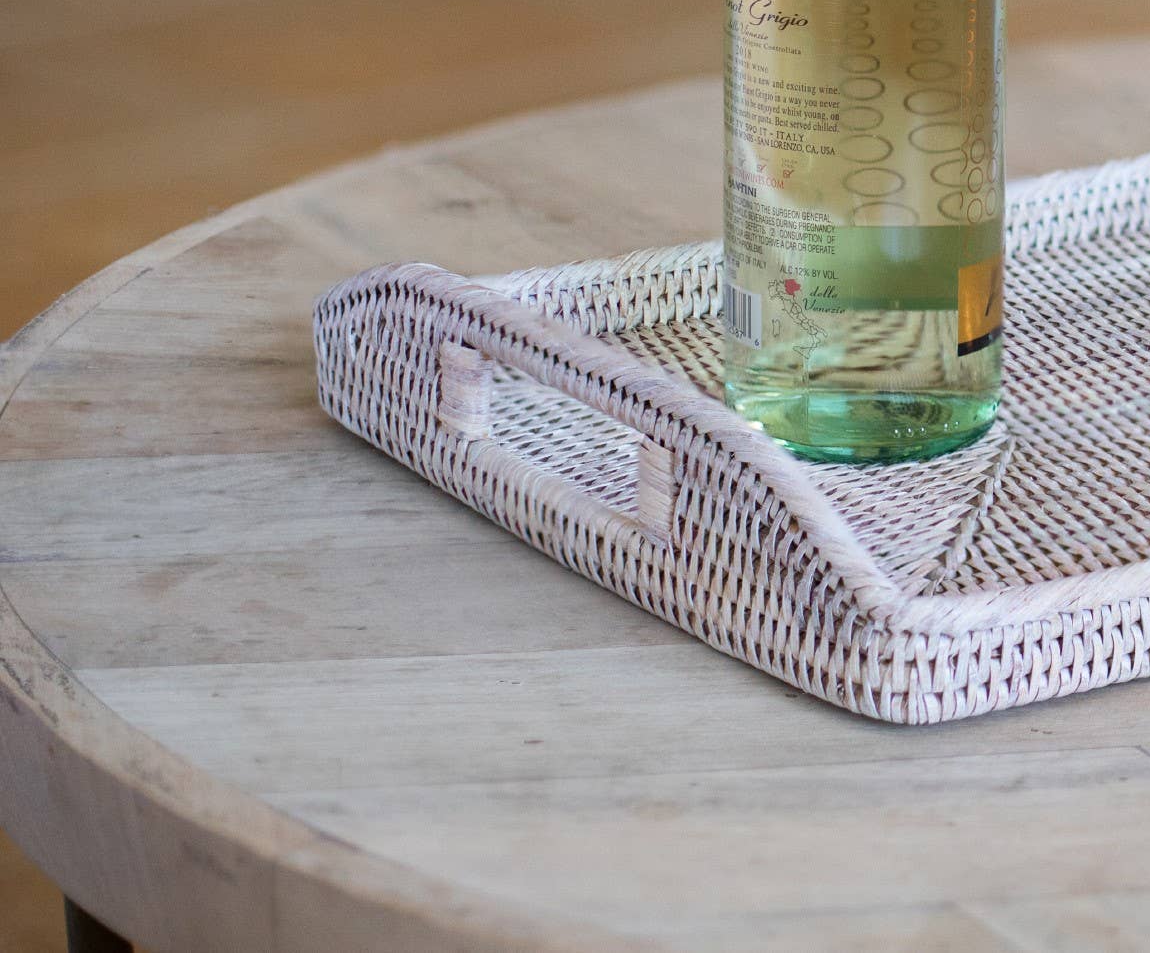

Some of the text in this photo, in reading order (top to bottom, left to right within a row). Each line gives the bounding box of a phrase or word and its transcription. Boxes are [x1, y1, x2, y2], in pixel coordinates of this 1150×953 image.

[763, 43, 802, 55] Controllata
[772, 80, 784, 89] and
[786, 82, 817, 96] exciting
[819, 85, 841, 95] wine.
[789, 97, 802, 107] way
[804, 99, 817, 108] you
[819, 99, 841, 108] never
[782, 106, 803, 117] whilst
[830, 113, 840, 121] on
[774, 117, 788, 128] Best
[790, 120, 812, 131] served
[813, 121, 840, 133] chilled.
[776, 130, 805, 143] ITALY
[757, 136, 770, 147] SAN
[770, 138, 804, 153] LORENZO,
[806, 143, 819, 155] CA,
[820, 146, 836, 156] USA
[761, 204, 771, 215] THE
[772, 206, 801, 219] SURGEON
[776, 217, 797, 230] DURING
[798, 221, 836, 234] PREGNANCY
[779, 230, 823, 243] CONSUMPTION
[827, 235, 836, 244] OF
[785, 242, 797, 252] CAR
[797, 244, 807, 253] OR
[808, 245, 836, 255] OPERATE
[802, 298, 846, 314] Venezie
[754, 338, 760, 347] 6
